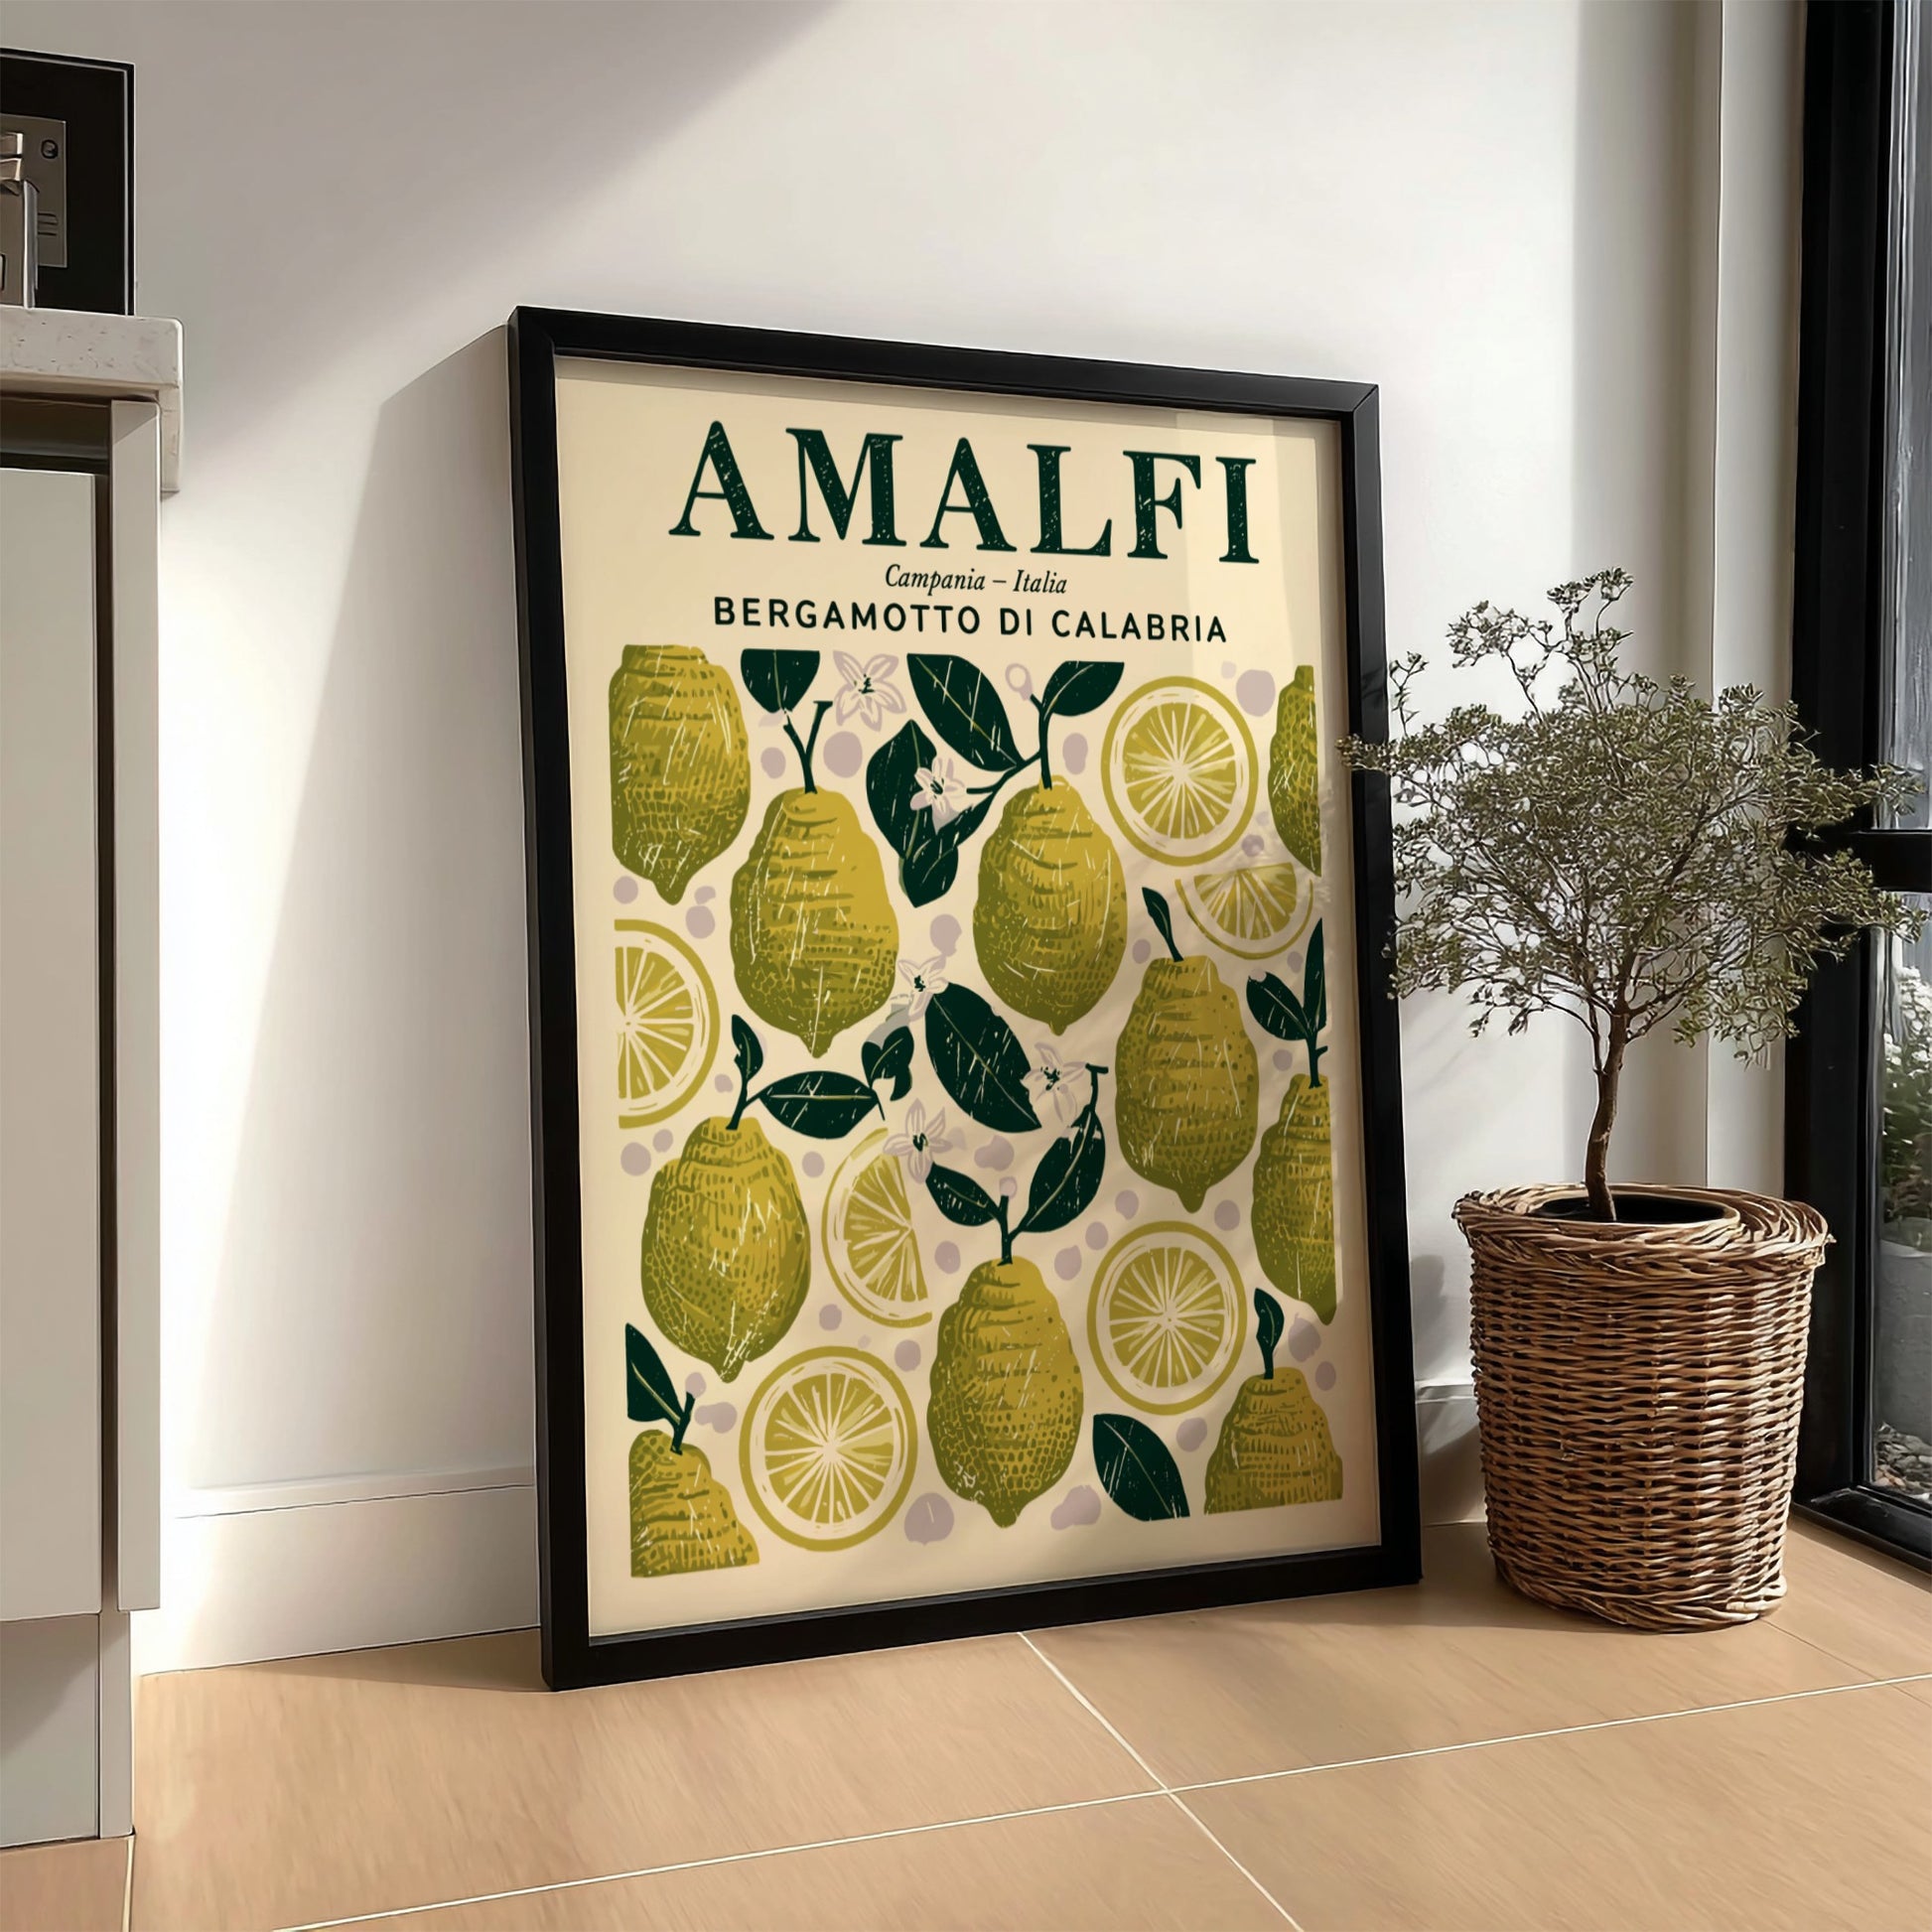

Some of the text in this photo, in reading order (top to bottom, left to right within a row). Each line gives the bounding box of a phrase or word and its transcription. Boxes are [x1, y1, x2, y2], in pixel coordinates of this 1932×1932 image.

[668, 420, 1260, 565] AMALFI
[885, 563, 986, 597] Campania
[1013, 569, 1067, 595] Italia
[714, 596, 1227, 643] BERGAMOTTO DI CALABRIA
